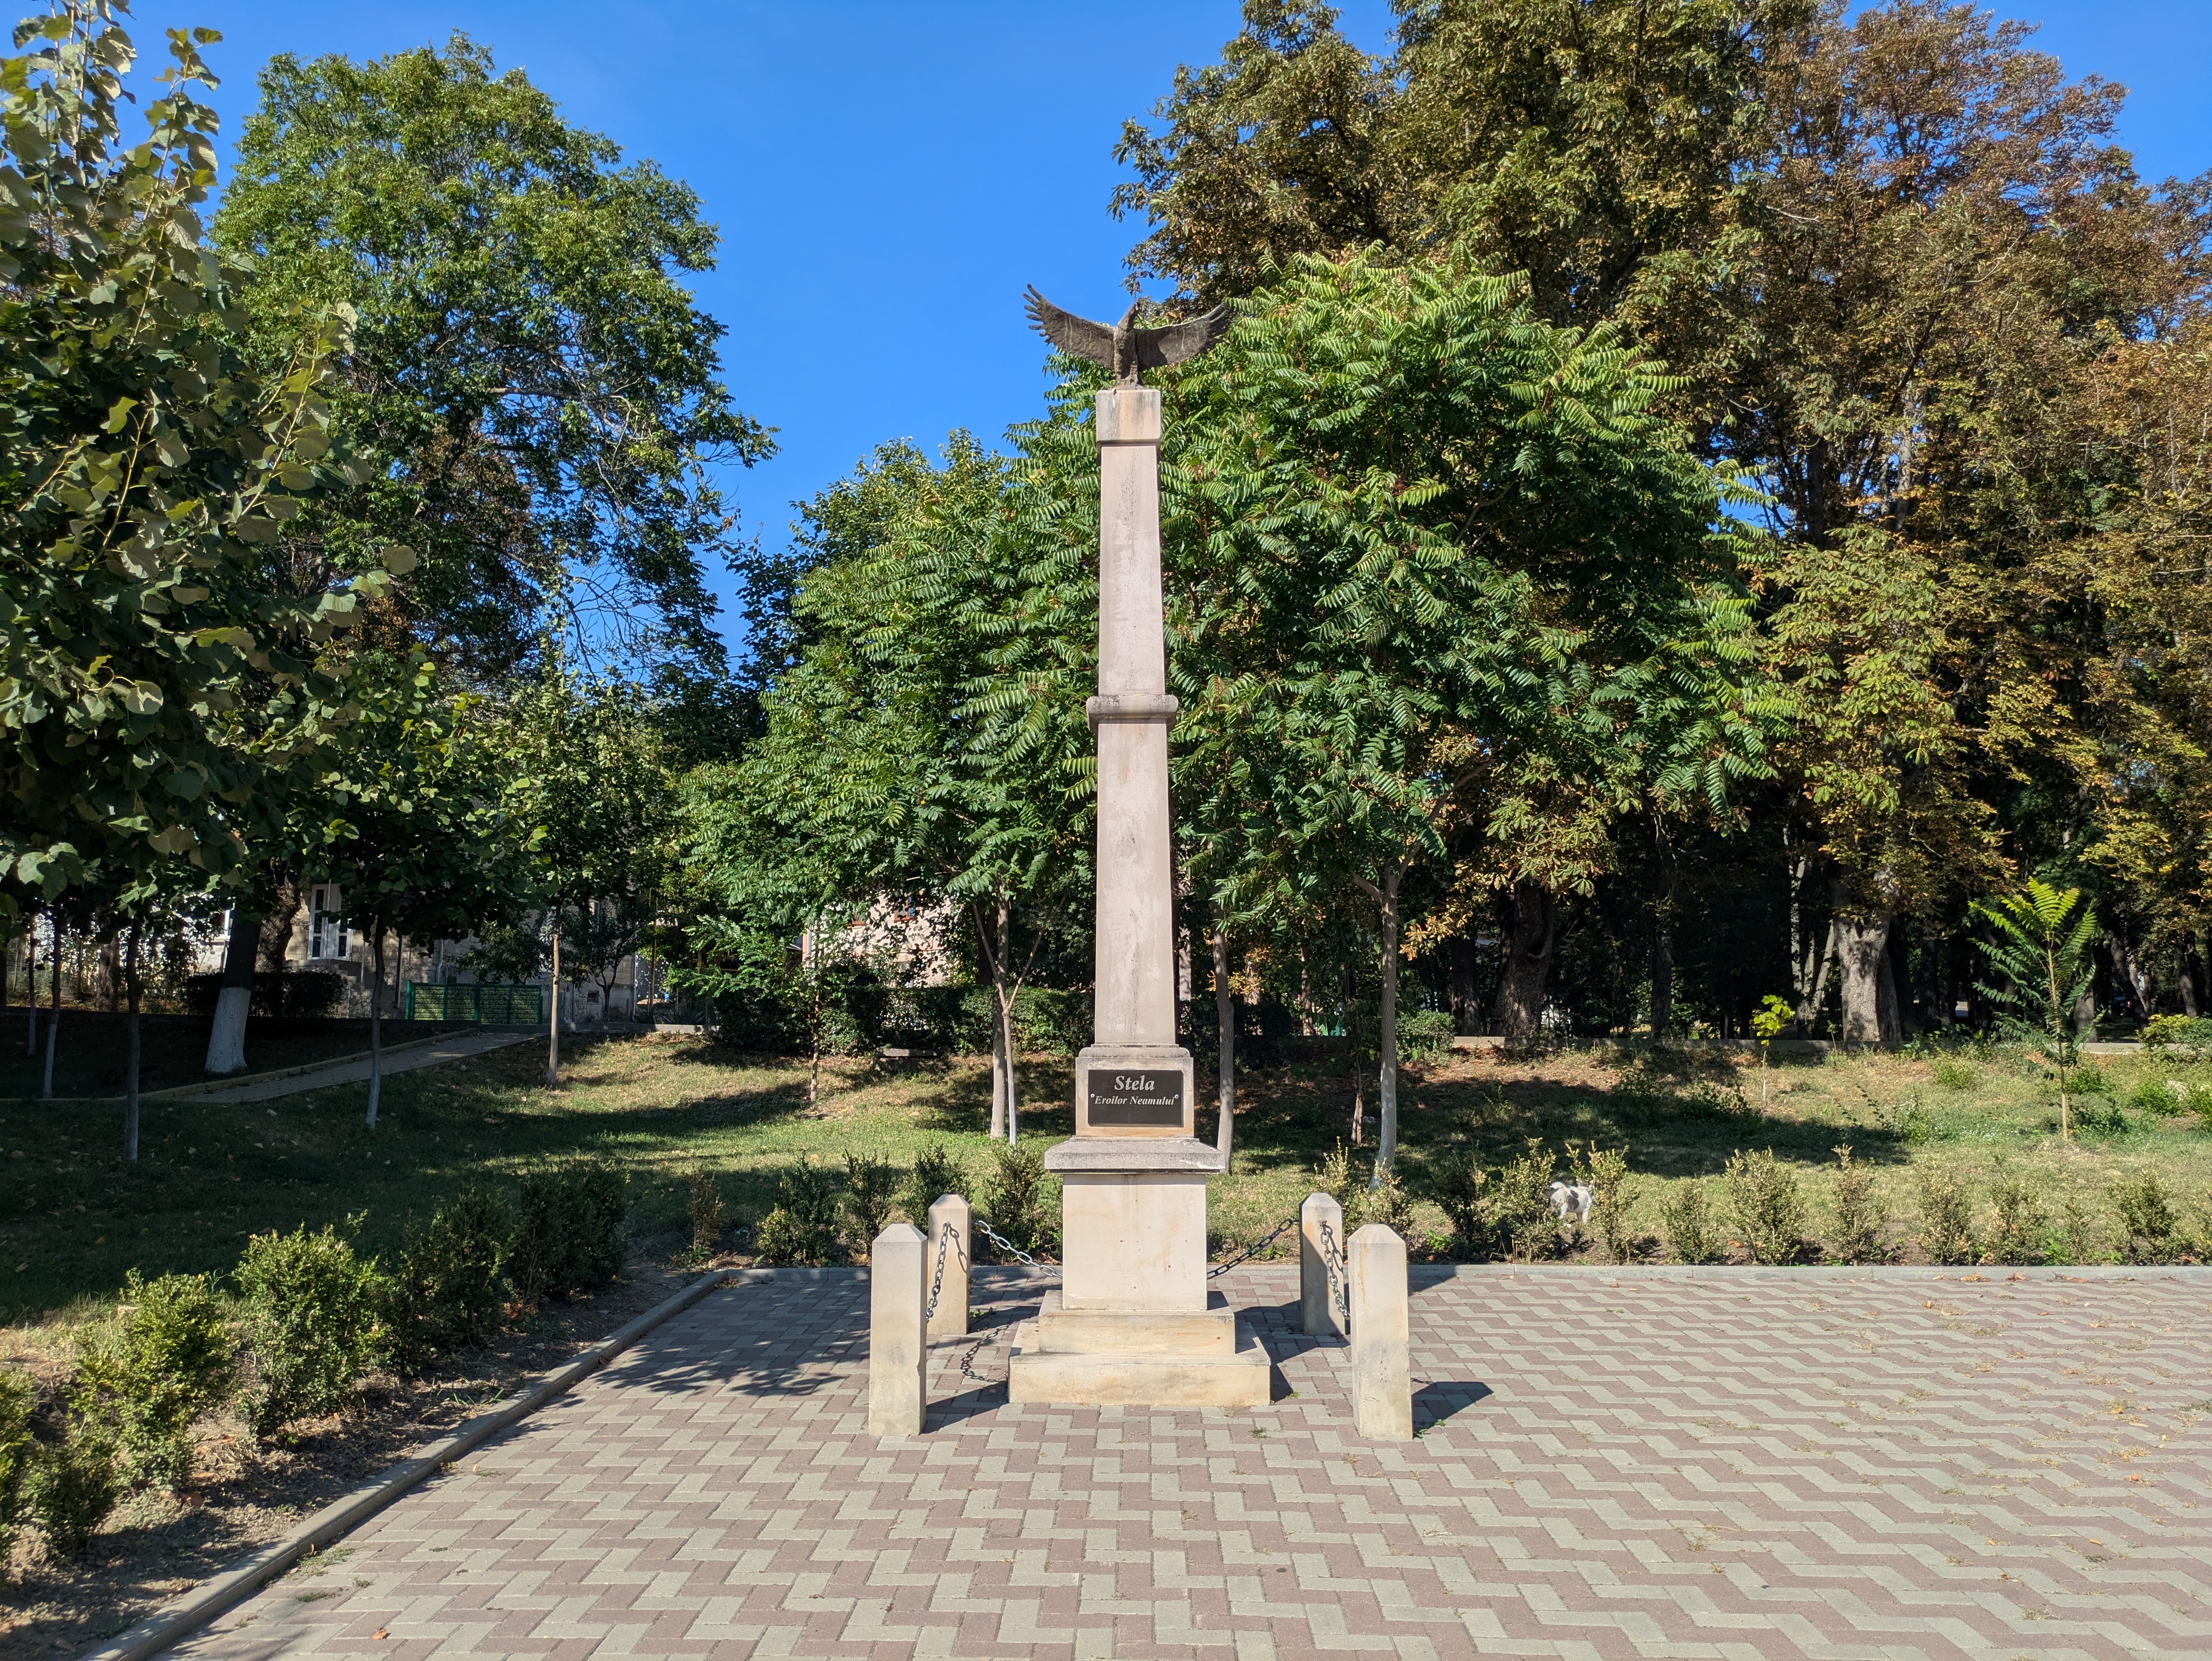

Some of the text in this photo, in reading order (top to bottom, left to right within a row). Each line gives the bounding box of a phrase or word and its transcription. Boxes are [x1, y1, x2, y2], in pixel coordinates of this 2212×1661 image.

[1114, 1075, 1155, 1091] Stela
[1094, 1096, 1175, 1105] Eroilor Neamului
